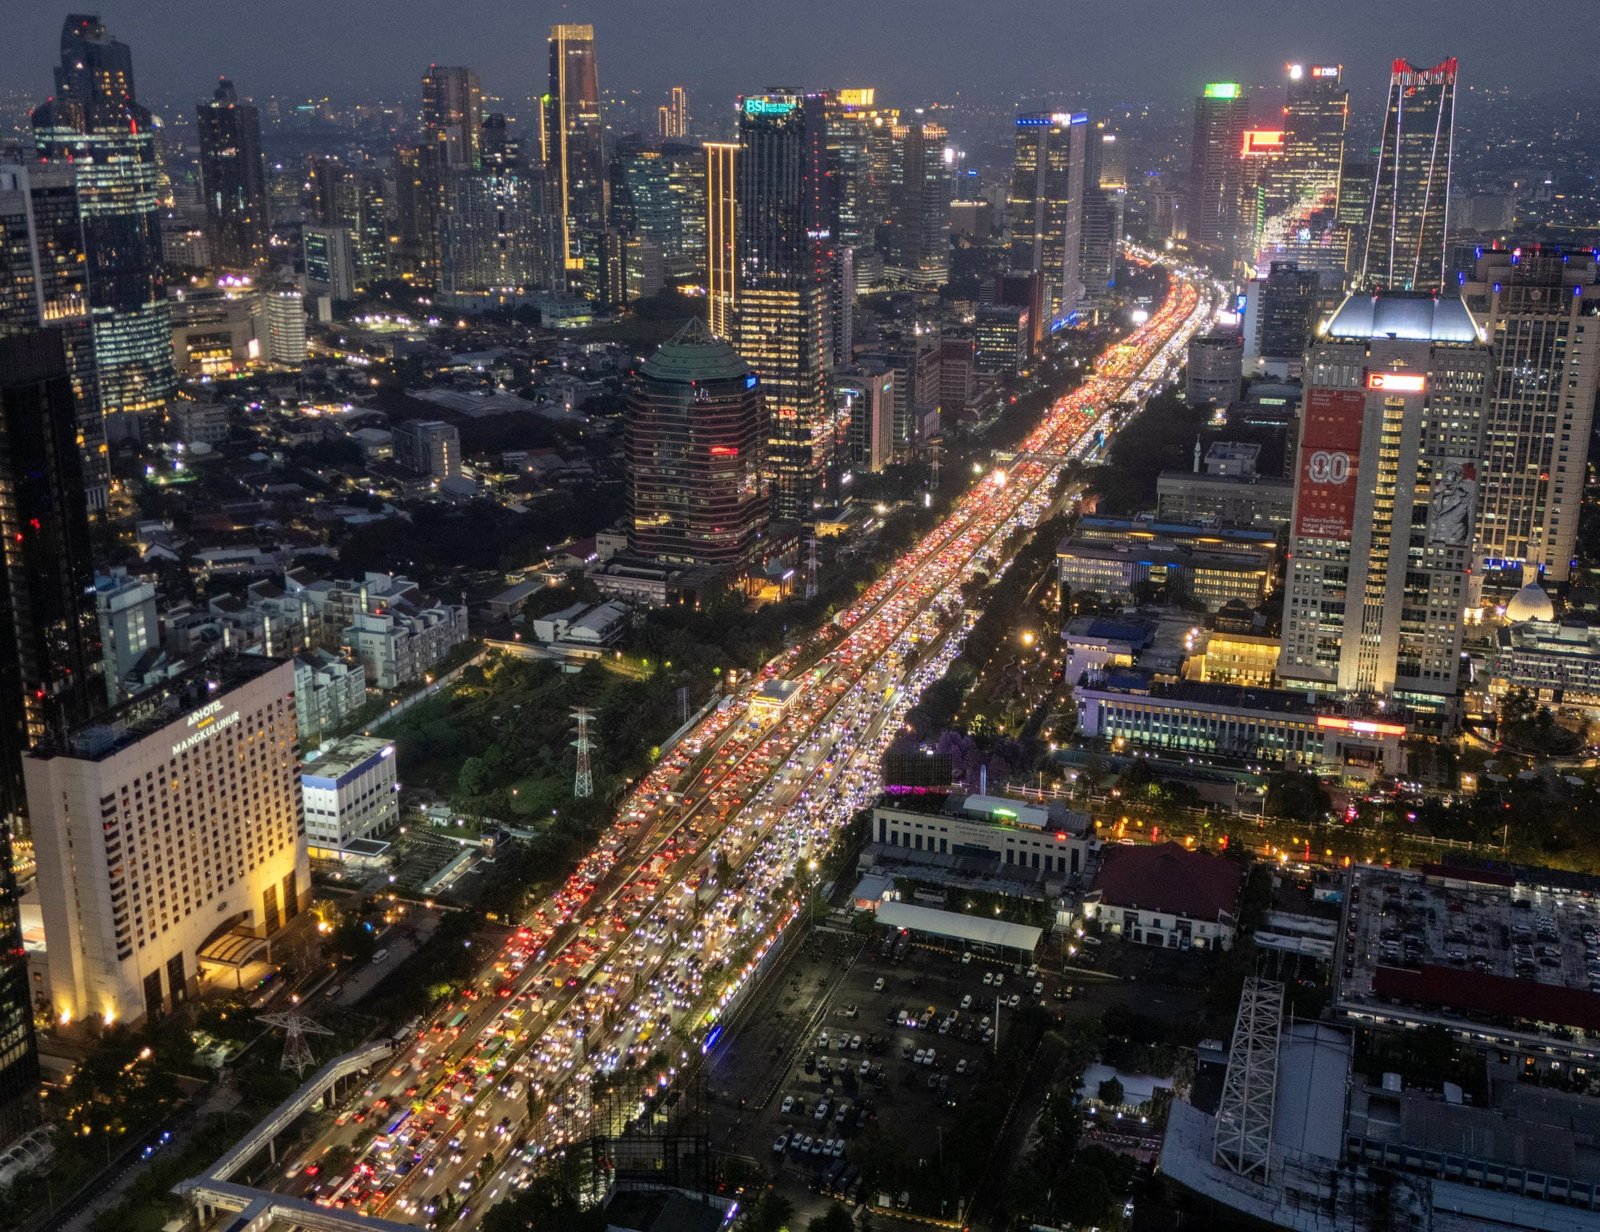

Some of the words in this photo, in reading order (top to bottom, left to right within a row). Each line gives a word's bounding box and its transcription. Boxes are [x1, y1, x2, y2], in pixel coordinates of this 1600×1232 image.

[1321, 67, 1338, 76] DBS
[746, 100, 766, 113] BSI
[1309, 451, 1350, 484] 80
[172, 711, 240, 755] MANGKULUHUR
